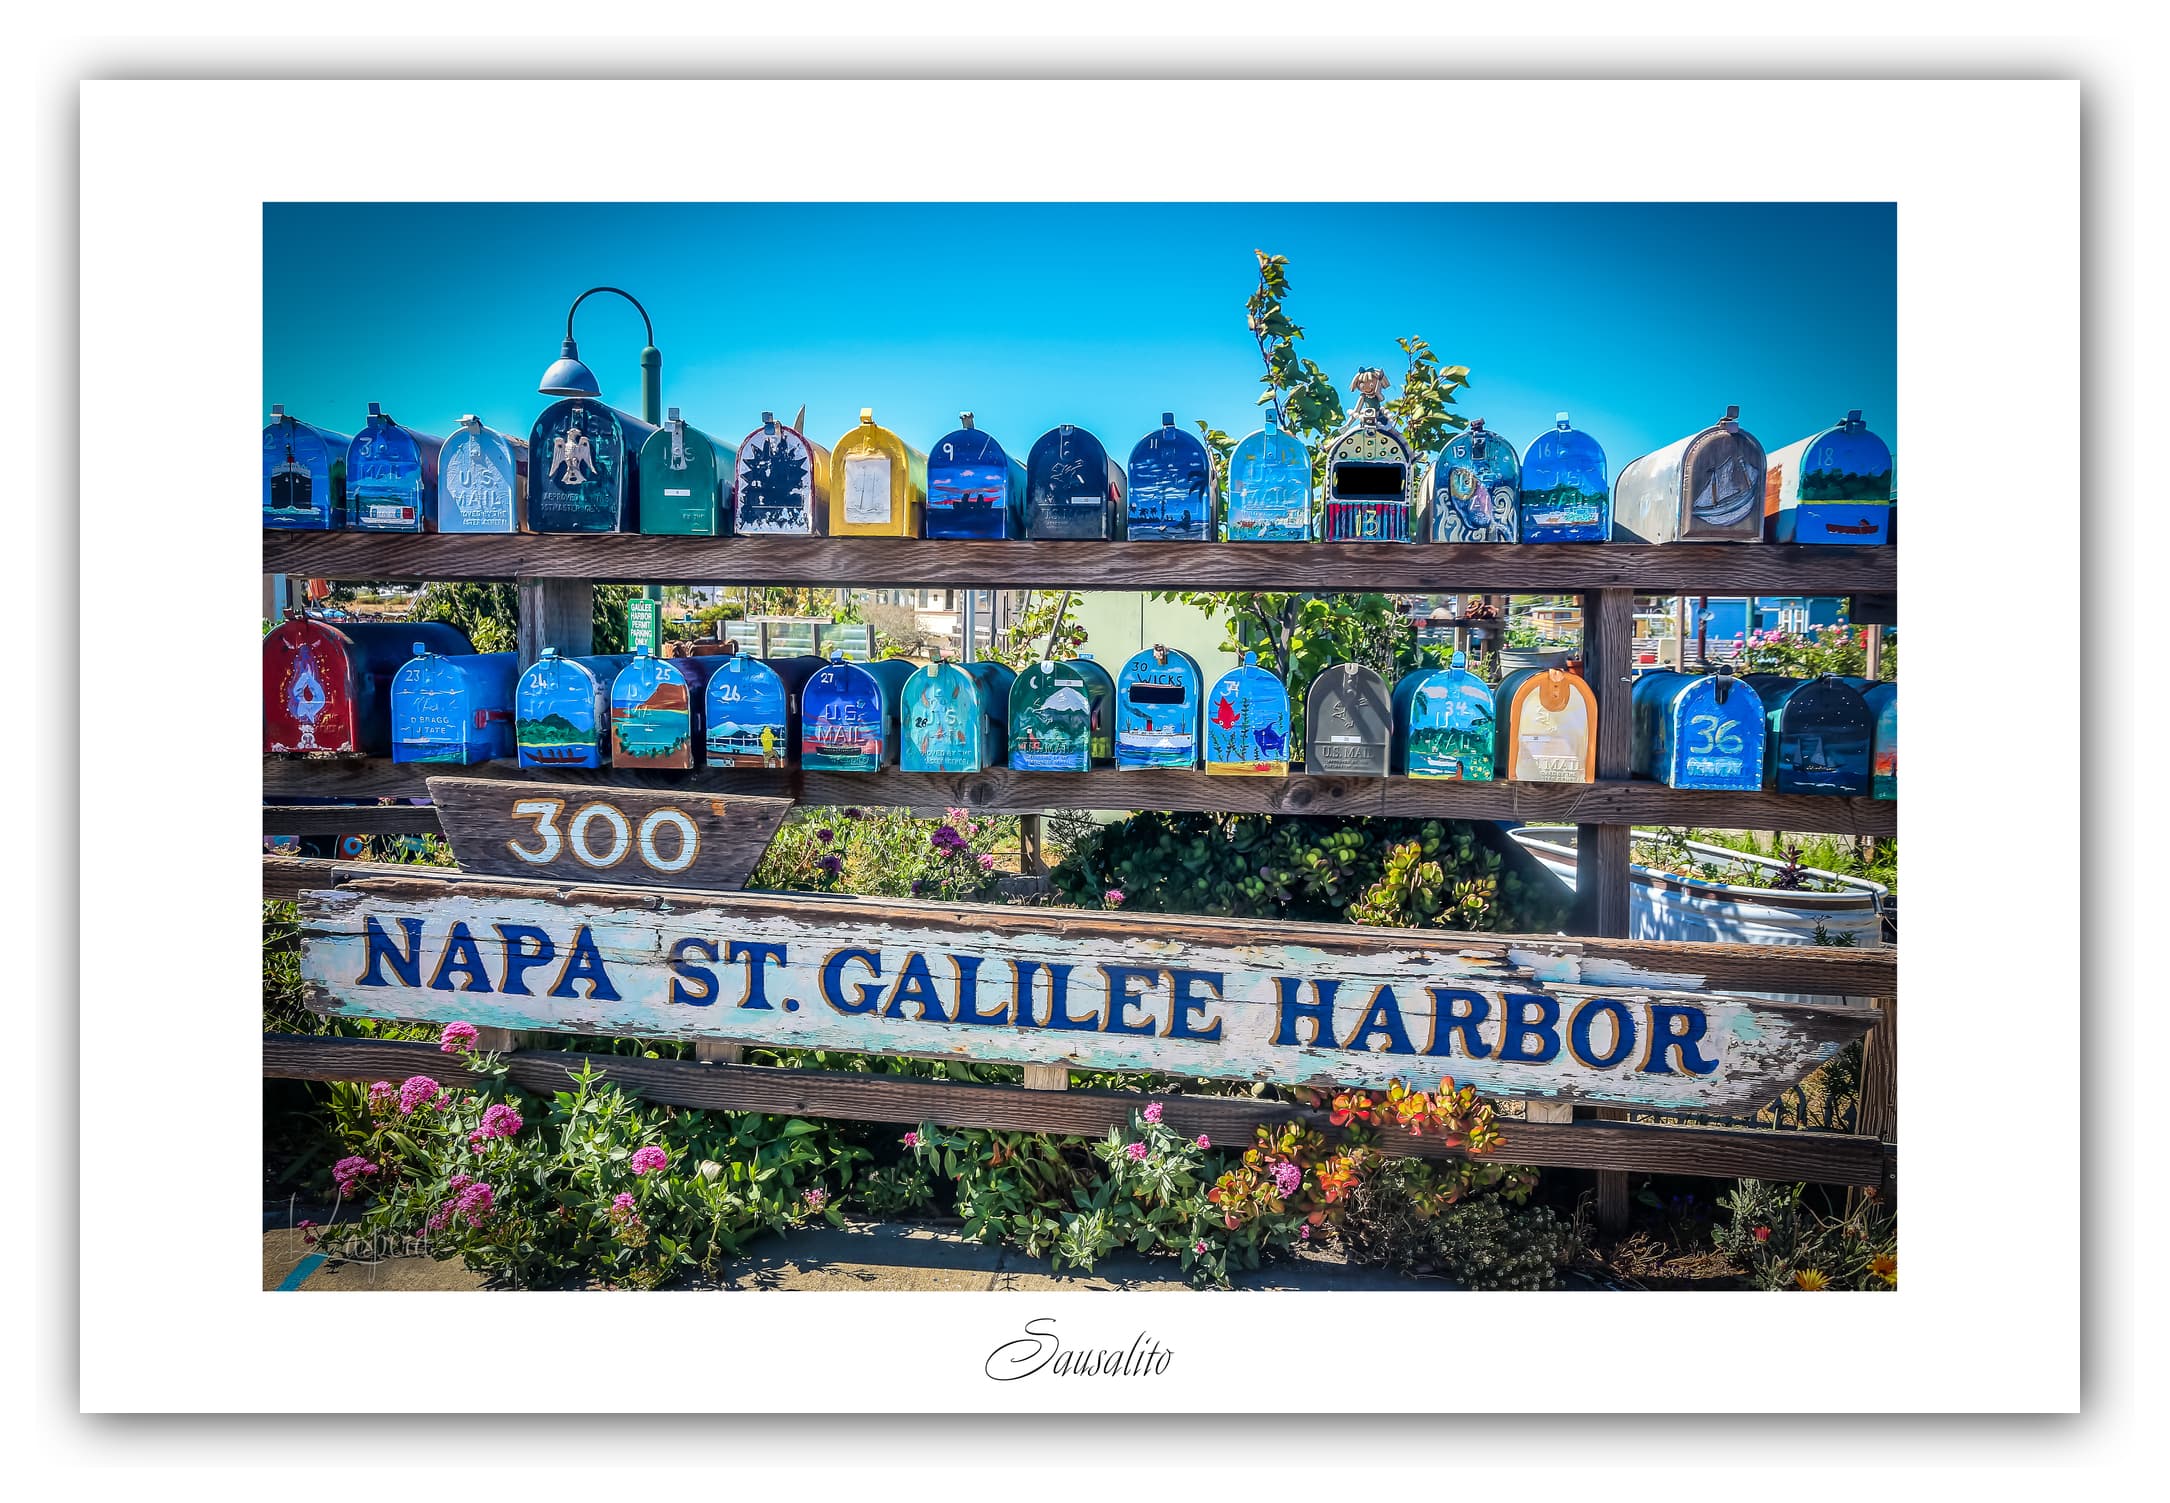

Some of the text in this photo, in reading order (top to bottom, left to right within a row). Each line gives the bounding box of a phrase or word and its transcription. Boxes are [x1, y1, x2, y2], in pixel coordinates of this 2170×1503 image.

[264, 433, 277, 450] 2
[359, 436, 373, 457] 3
[1149, 438, 1159, 449] 11
[942, 442, 954, 461] 9
[1451, 445, 1466, 458] 15
[1538, 442, 1552, 460] 16
[1817, 447, 1834, 466] 18
[459, 469, 499, 489] U.S.
[1355, 509, 1380, 538] 13
[630, 612, 653, 620] HARBOR
[631, 621, 651, 629] PERMIT
[630, 629, 653, 637] PARKING
[655, 667, 672, 681] 25
[1131, 661, 1148, 672] 30
[405, 669, 421, 682] 23
[529, 673, 547, 689] 24
[820, 672, 834, 684] 27
[1137, 673, 1183, 687] WICKS
[719, 684, 741, 702] 26
[419, 716, 450, 724] BRAGG
[424, 726, 446, 734] TATE
[818, 725, 866, 744] MAIL
[1689, 714, 1744, 755] 36
[1321, 745, 1374, 759] U.S. MAIL
[506, 797, 701, 875] 300
[354, 915, 1721, 1077] NAPA ST. GALILEE HARBOR
